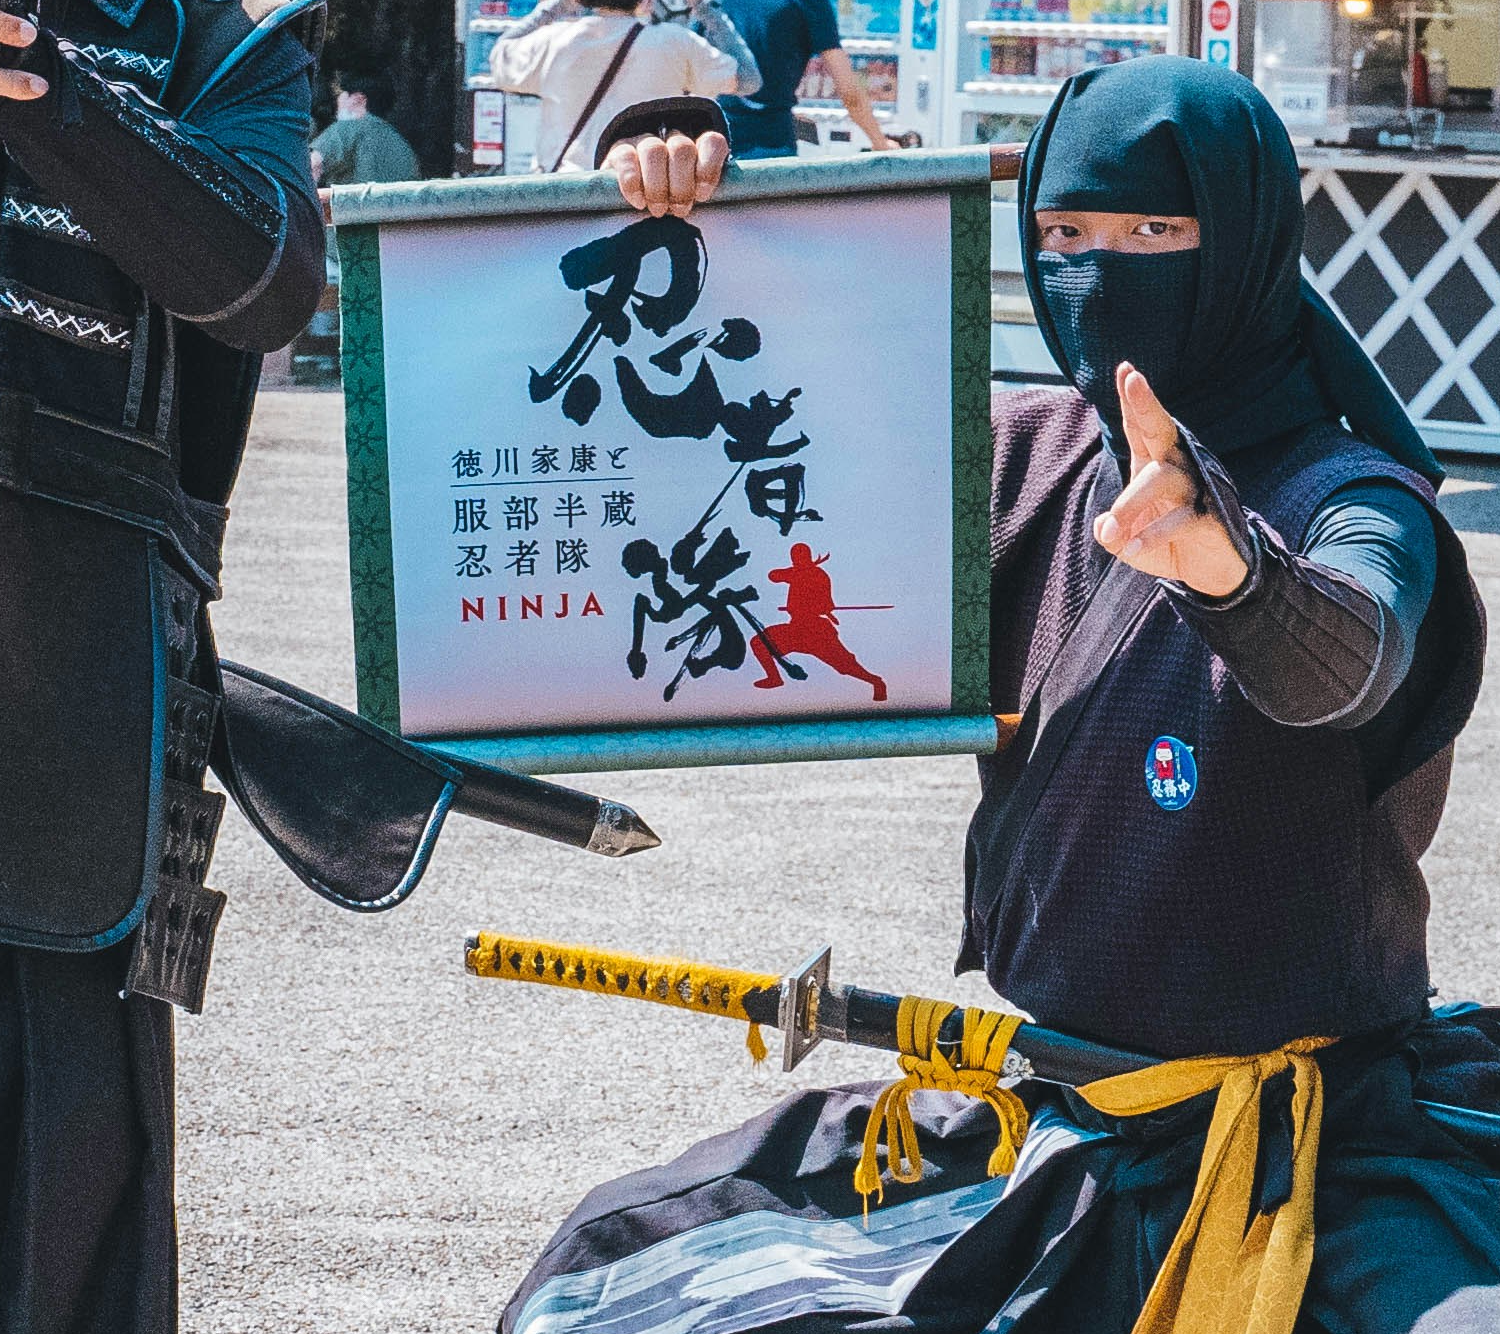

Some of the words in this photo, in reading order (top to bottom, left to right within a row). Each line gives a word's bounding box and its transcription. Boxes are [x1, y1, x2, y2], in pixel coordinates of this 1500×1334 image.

[451, 444, 627, 479] 徳川家康と
[452, 489, 637, 535] 服部半蔵
[455, 537, 591, 578] 忍者隊
[460, 591, 605, 623] NINJA
[1152, 779, 1191, 798] 忍務中
